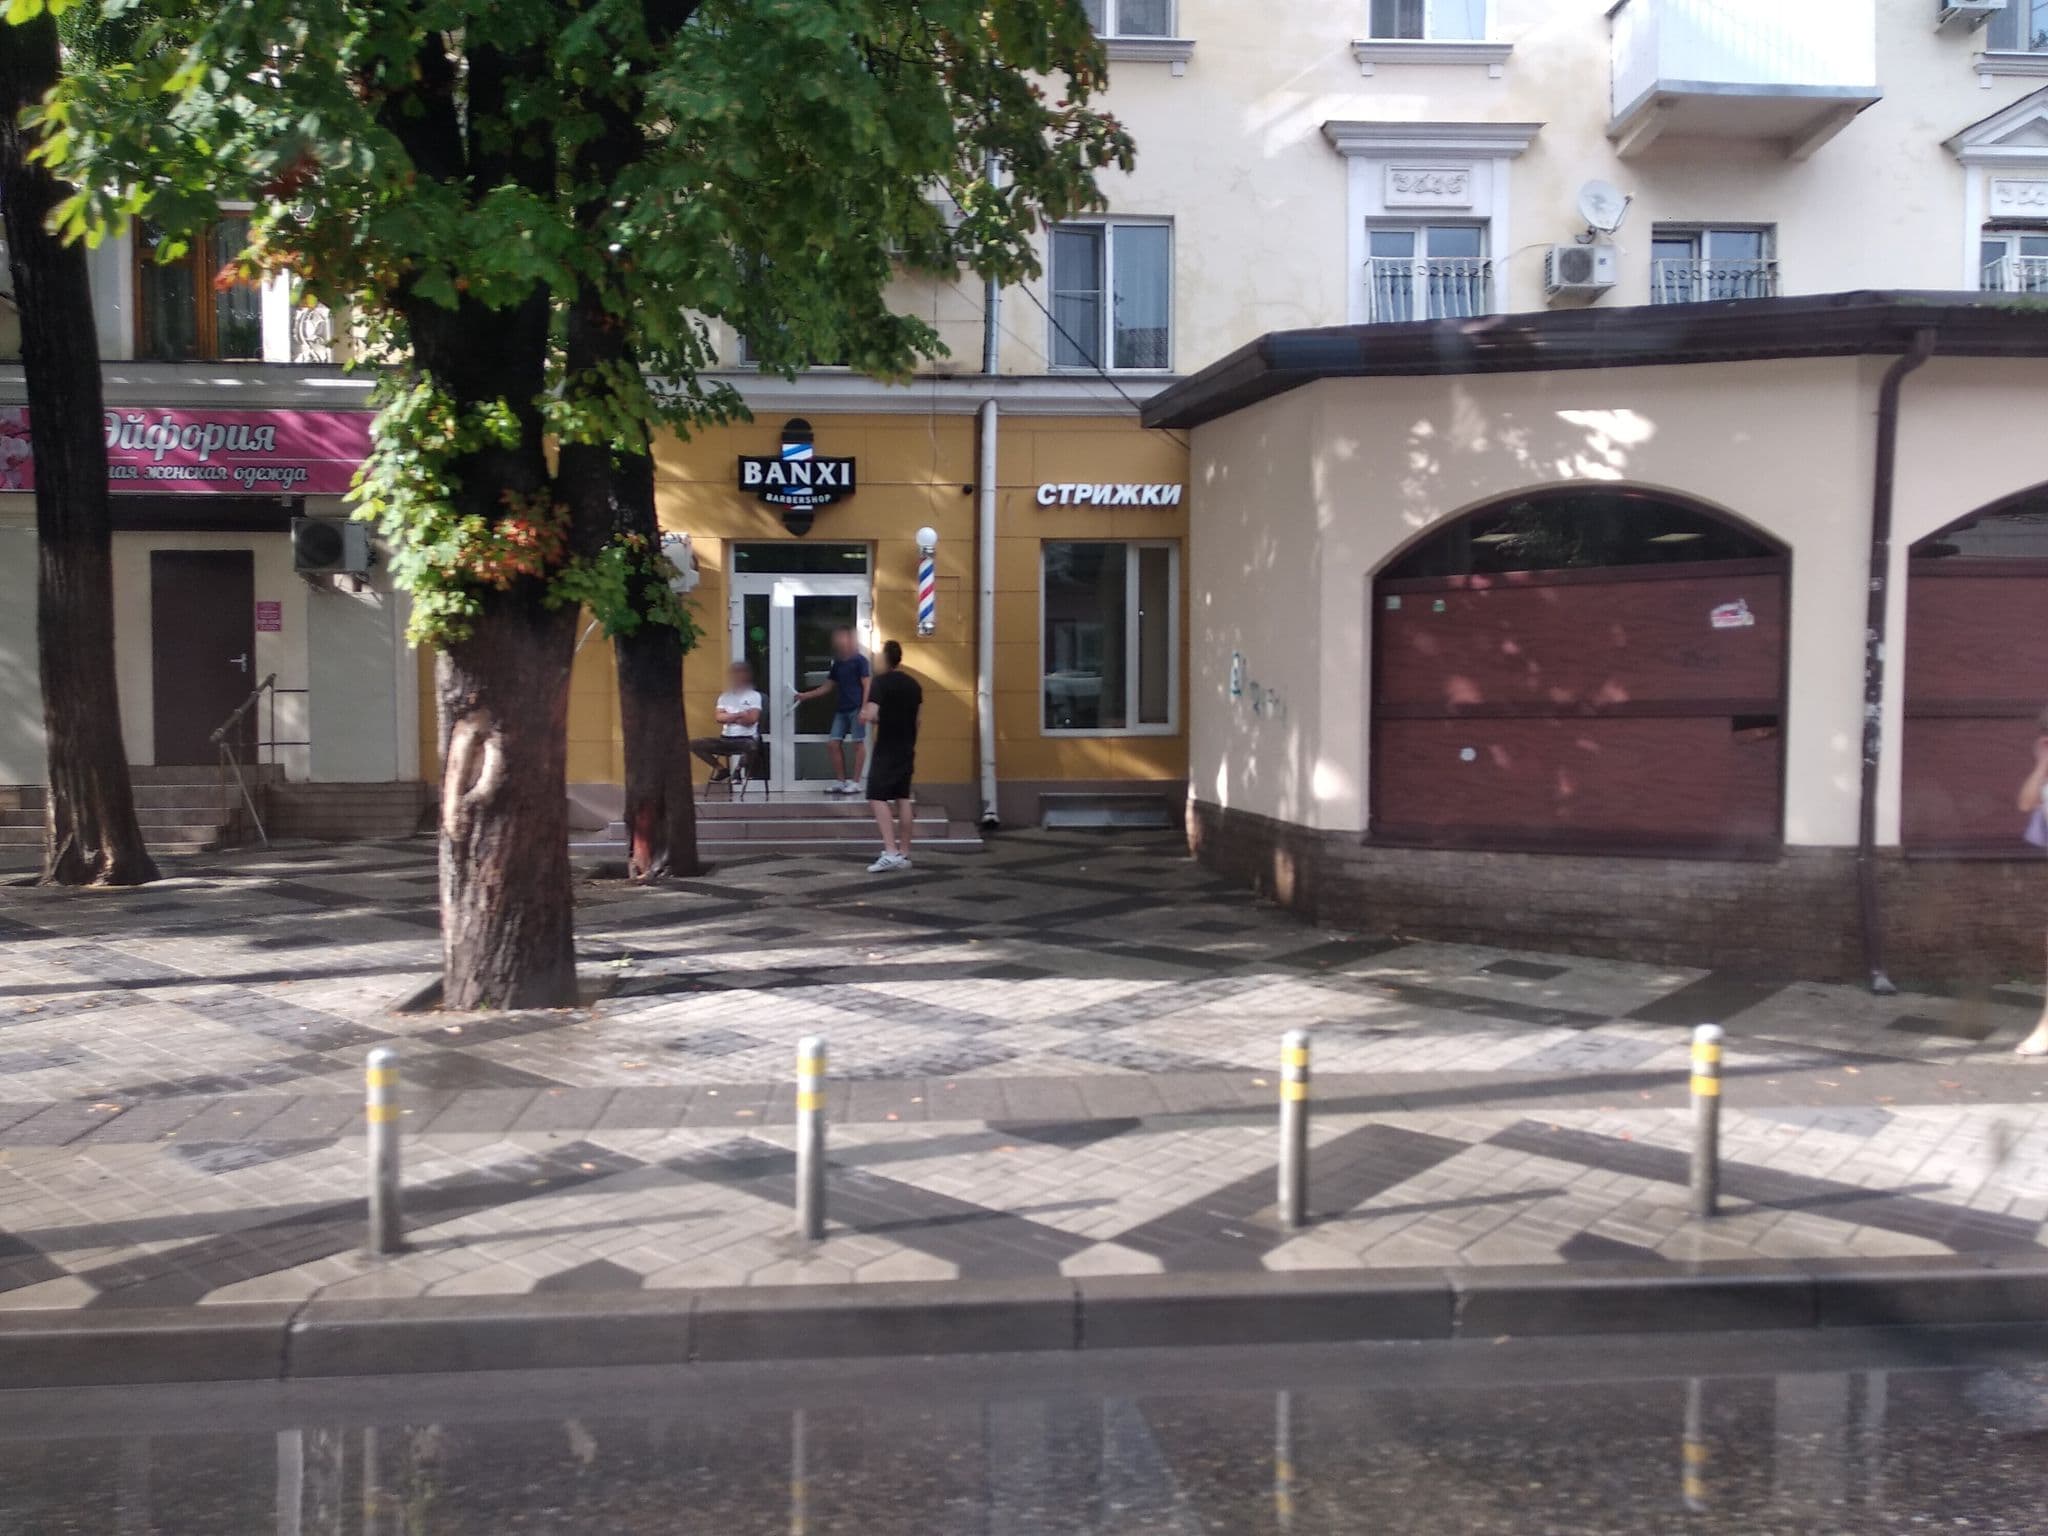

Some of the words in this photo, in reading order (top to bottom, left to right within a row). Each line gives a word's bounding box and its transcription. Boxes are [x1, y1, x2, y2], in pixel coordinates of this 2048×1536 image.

[144, 465, 228, 480] женская
[233, 465, 308, 489] одежда
[743, 461, 850, 485] BANXI
[766, 493, 831, 504] BARBERSHOP
[1037, 483, 1182, 505] СТРИЖКИ
